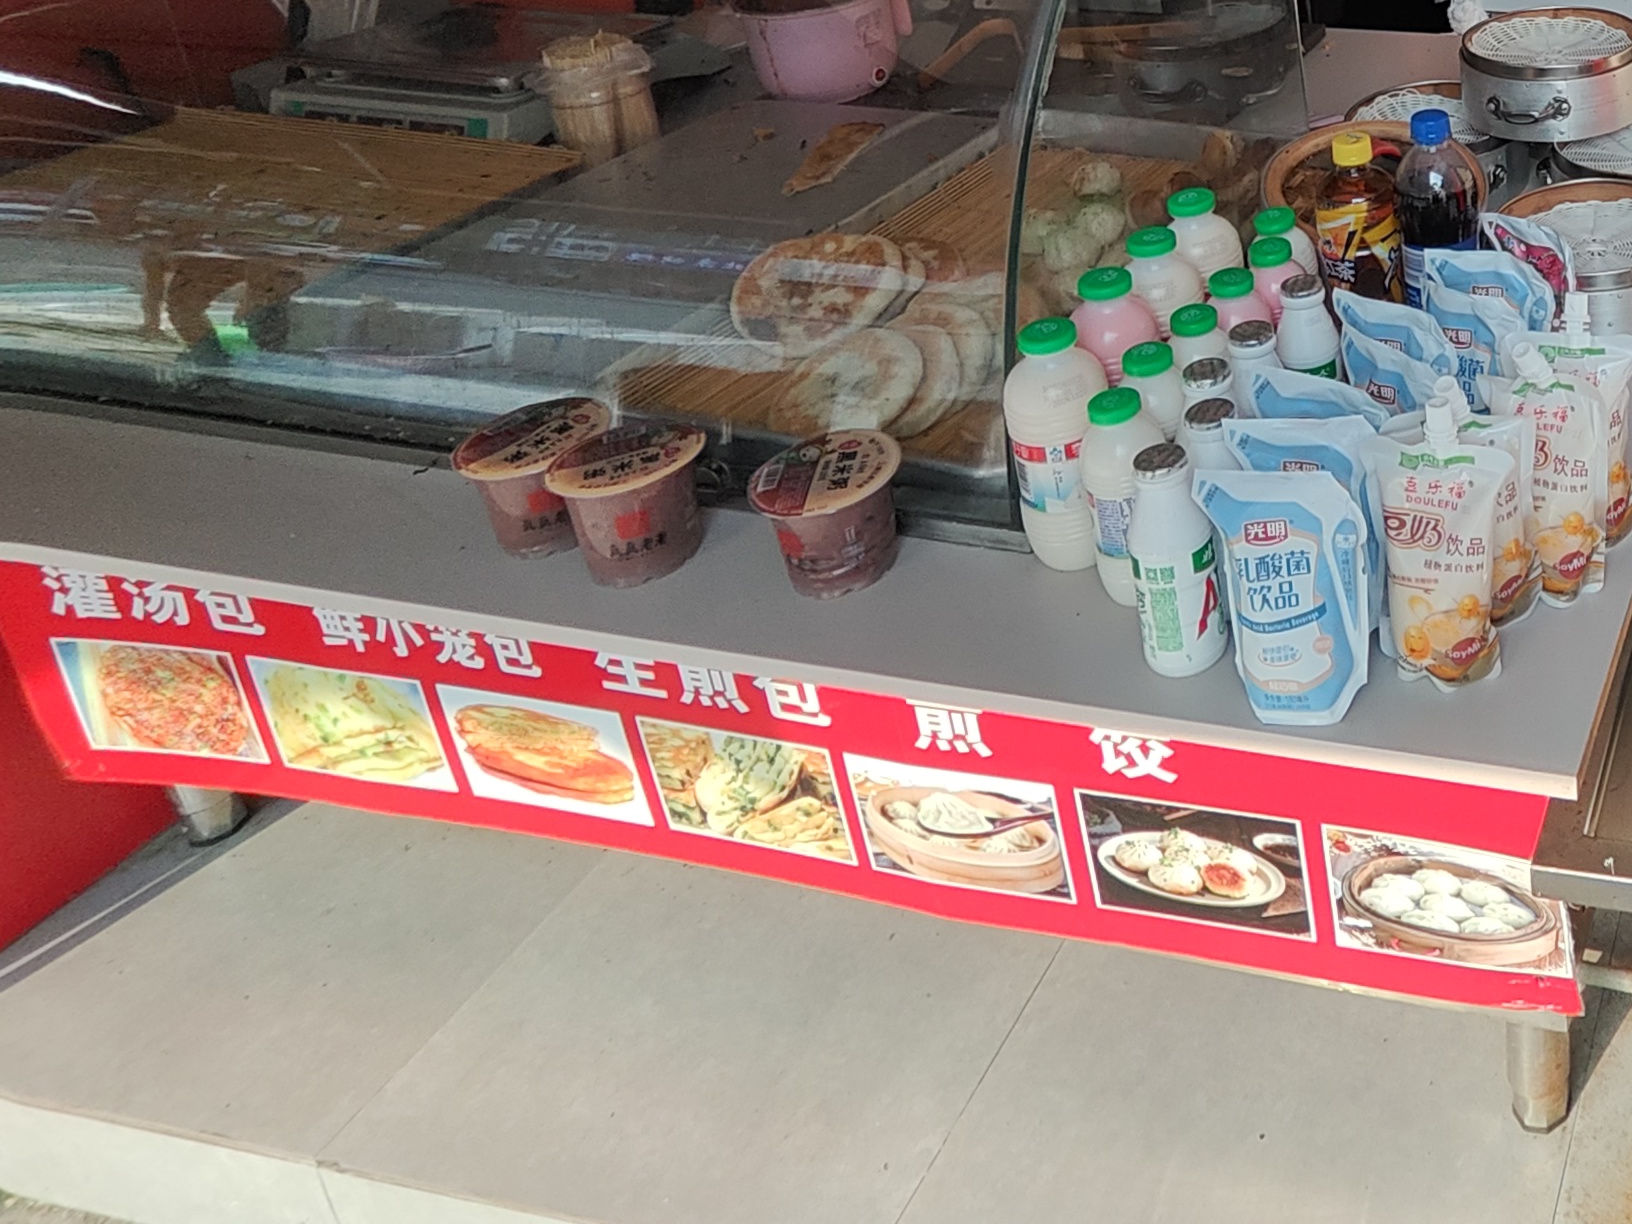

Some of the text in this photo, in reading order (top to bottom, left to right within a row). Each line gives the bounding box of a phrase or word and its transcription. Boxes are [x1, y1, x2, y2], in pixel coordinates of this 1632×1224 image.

[1443, 329, 1471, 345] 光明
[1368, 381, 1395, 402] 光明
[1536, 422, 1563, 434] LEFU
[1552, 454, 1589, 478] 饮品
[1406, 495, 1459, 511] DOULEFU
[1246, 521, 1286, 541] 光明
[1446, 533, 1486, 557] 饮品
[1234, 550, 1312, 584] 乳酸菌
[1423, 558, 1485, 574] 植物蛋白饮料
[1247, 580, 1300, 613] 饮品
[41, 565, 266, 636] 灌汤包
[312, 606, 542, 678] 鲜小笼包
[594, 651, 832, 728] 生煎包
